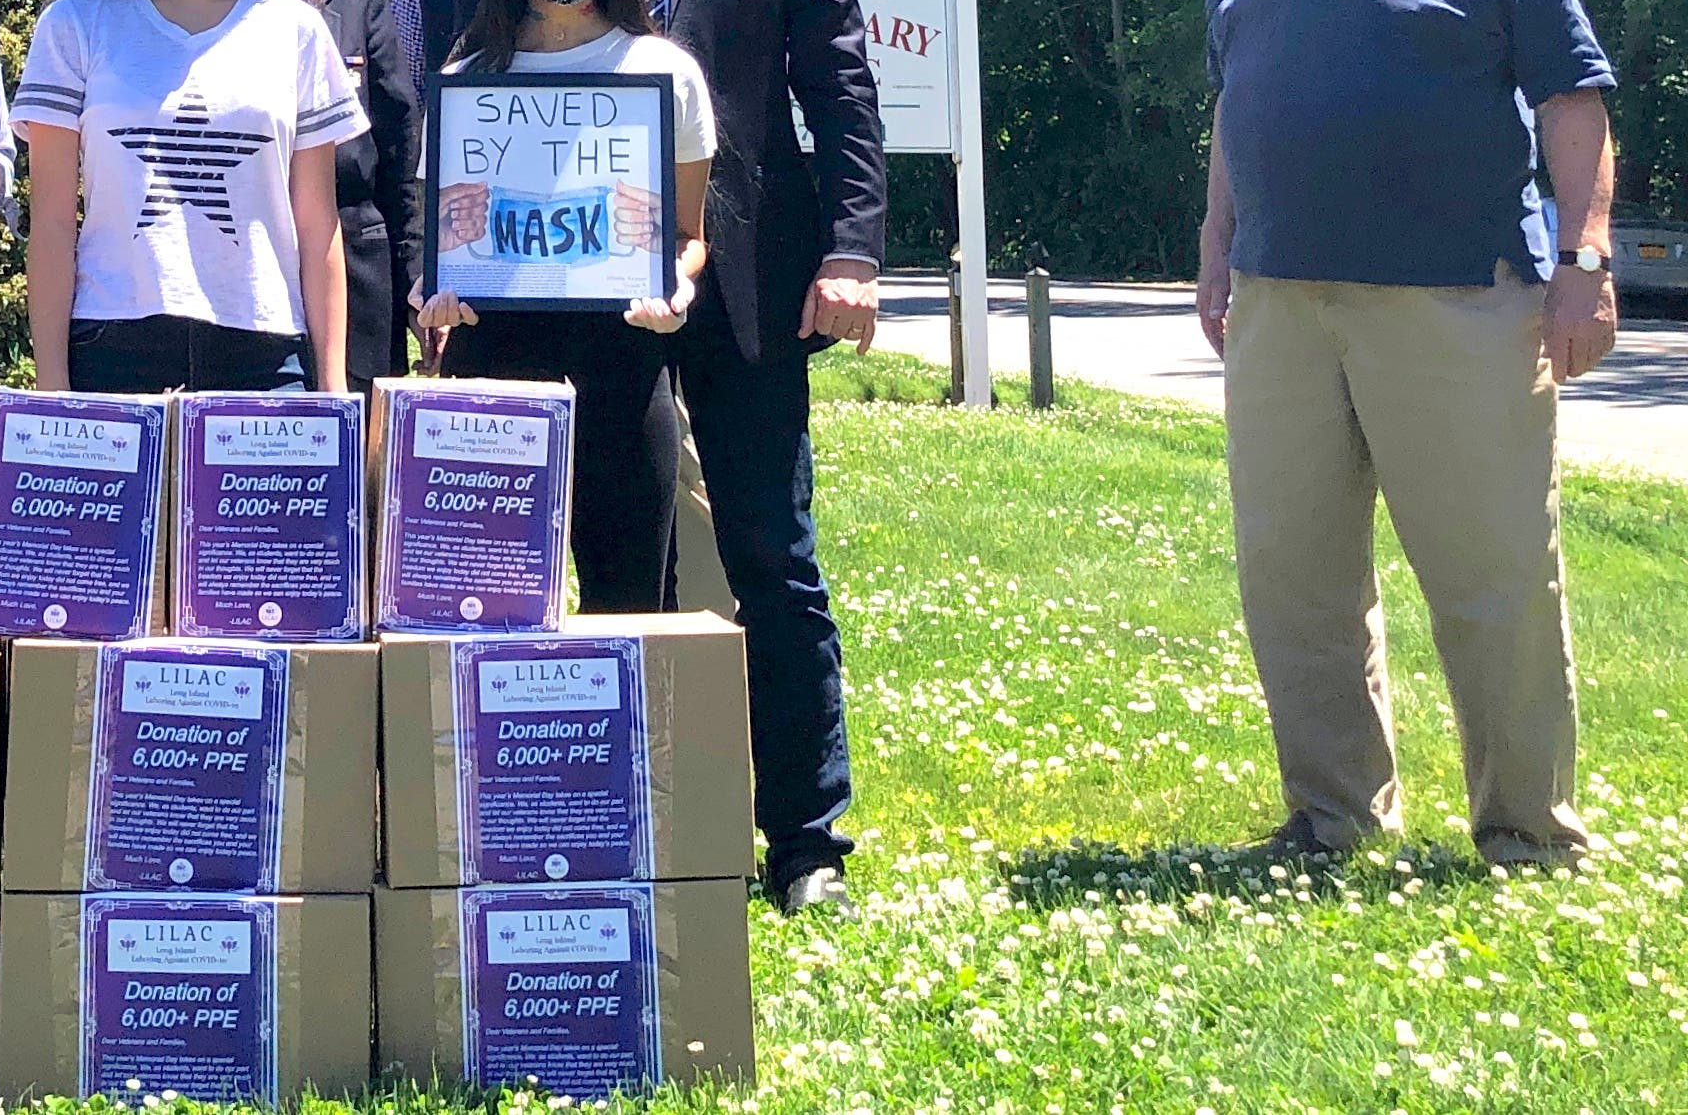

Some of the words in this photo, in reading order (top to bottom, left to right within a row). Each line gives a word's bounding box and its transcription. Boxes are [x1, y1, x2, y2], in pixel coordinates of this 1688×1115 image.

[476, 92, 618, 128] SAVED
[462, 136, 512, 176] BY
[541, 138, 631, 177] THE
[494, 204, 602, 257] MASK
[39, 421, 104, 438] LILAC
[239, 420, 303, 435] LILAC
[449, 417, 513, 433] LILAC
[15, 473, 99, 493] Donation
[102, 479, 125, 497] of
[220, 473, 301, 491] Donation
[307, 474, 328, 491] of
[428, 468, 509, 487] Donation
[513, 473, 535, 490] of
[10, 497, 76, 519] 6,000+
[79, 503, 123, 521] PPE
[218, 498, 281, 518] 6,000+
[286, 498, 328, 515] PPE
[424, 492, 487, 513] 6,000+
[491, 496, 534, 514] PPE
[159, 668, 226, 685] LILAC
[514, 663, 581, 680] LILAC
[136, 722, 222, 742] Donation
[226, 726, 249, 745] of
[497, 719, 583, 739] Donation
[587, 718, 610, 736] of
[132, 748, 199, 770] 6,000+
[203, 752, 248, 770] PPE
[496, 745, 563, 768] 6,000+
[566, 744, 611, 763] PPE
[144, 925, 212, 940] LILAC
[523, 914, 591, 930] LILAC
[505, 970, 592, 990] Donation
[596, 970, 620, 988] of
[124, 981, 210, 1000] Donation
[216, 982, 238, 1001] of
[504, 997, 571, 1019] 6,000+
[575, 996, 621, 1015] PPE
[121, 1008, 188, 1030] 6,000+
[193, 1009, 238, 1028] PPE
